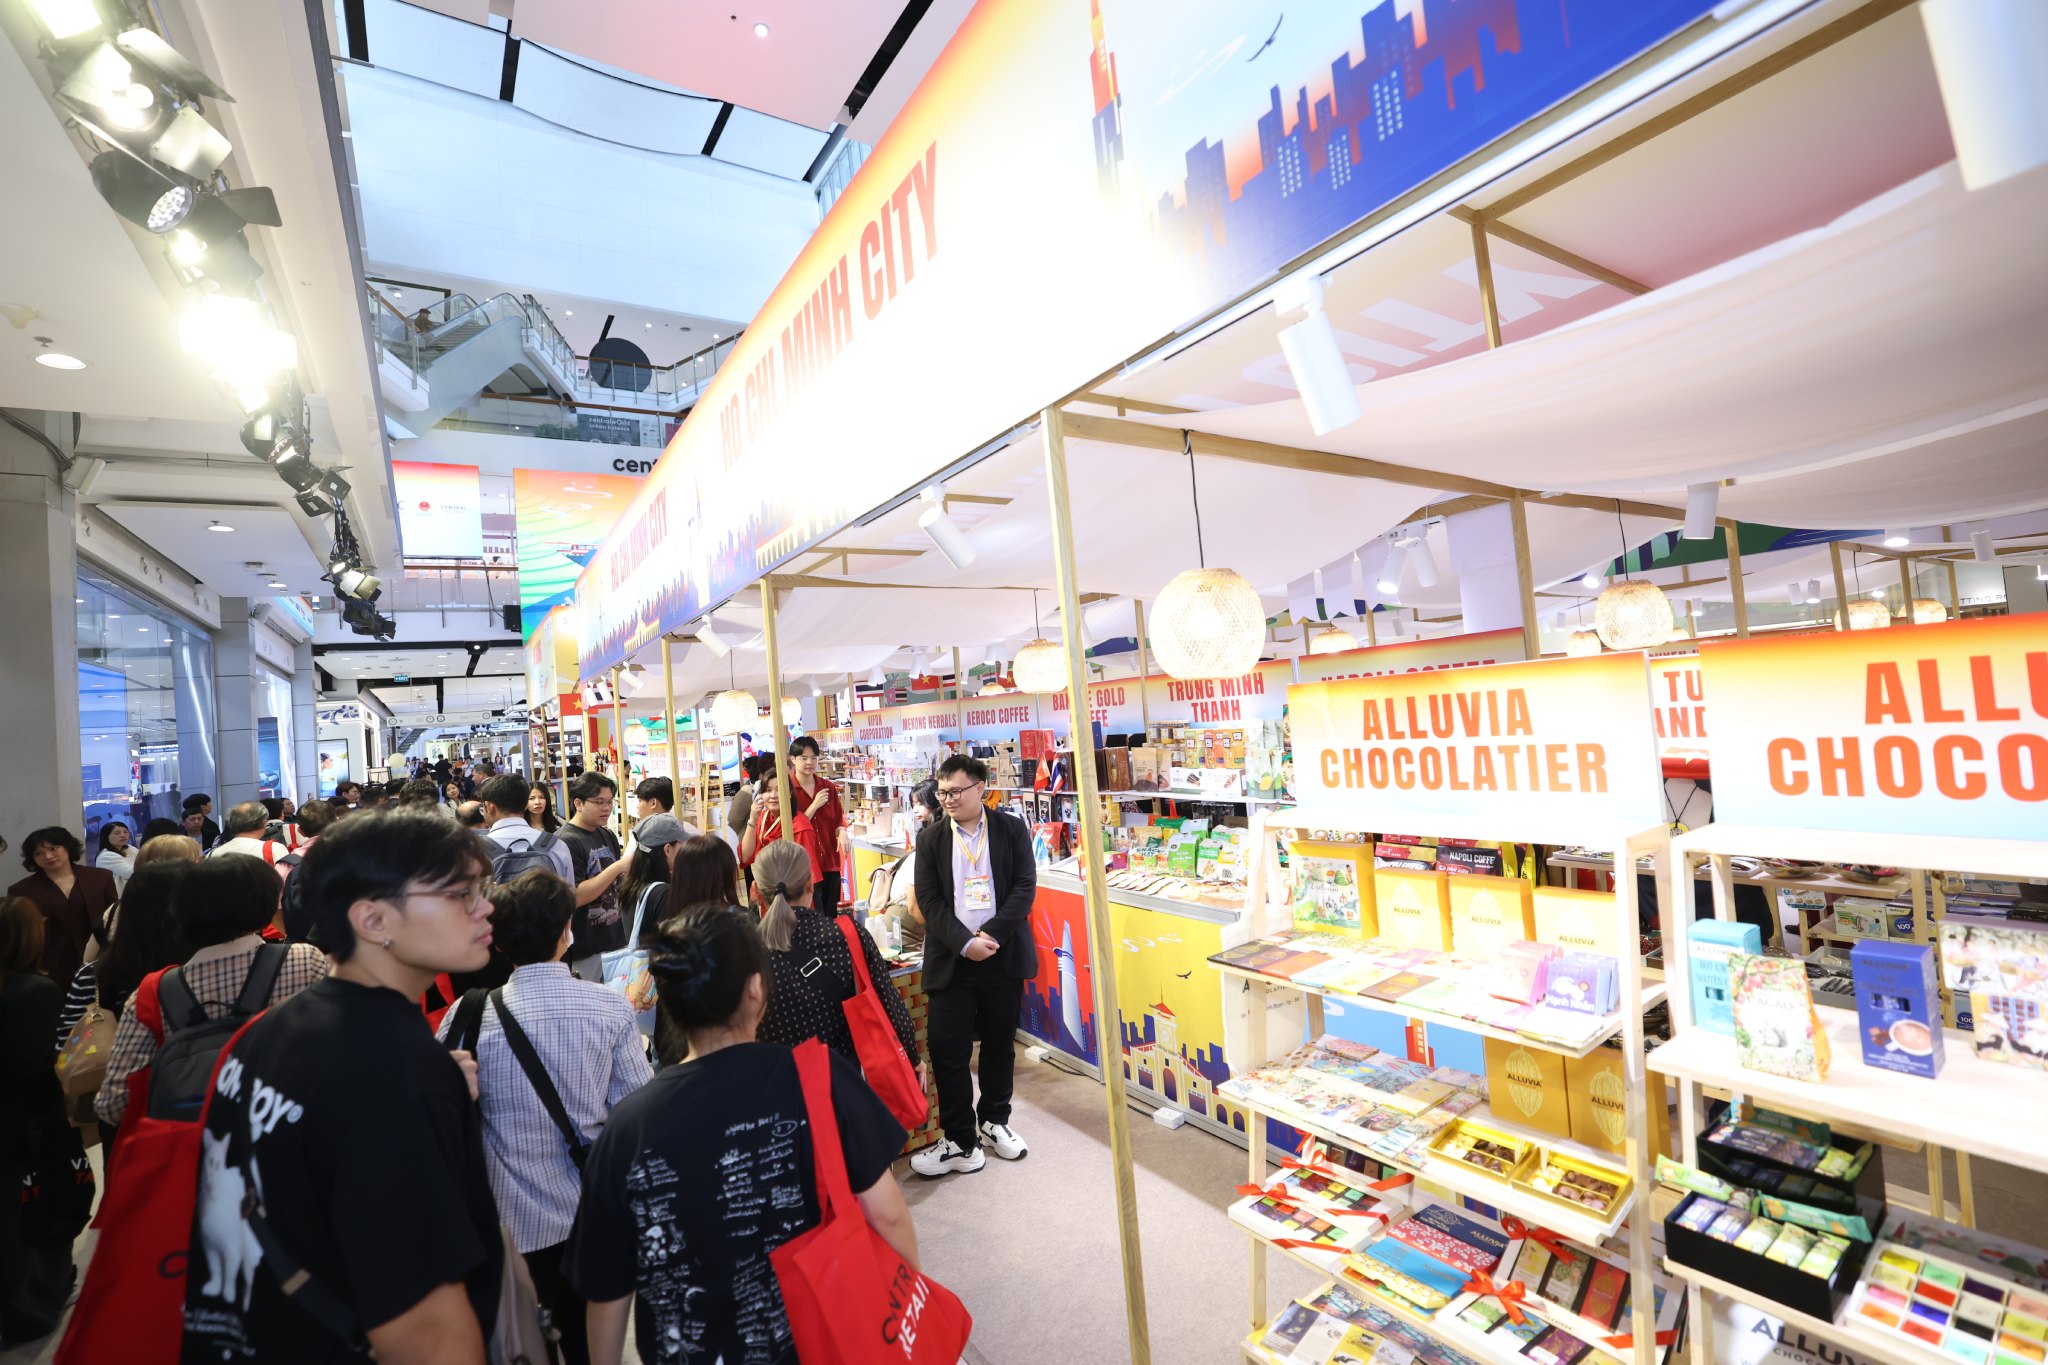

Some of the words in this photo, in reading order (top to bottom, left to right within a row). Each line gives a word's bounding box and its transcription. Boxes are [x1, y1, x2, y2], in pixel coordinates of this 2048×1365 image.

[720, 393, 741, 473] HO
[745, 347, 778, 443] CHI
[780, 253, 854, 406] MINH
[859, 139, 938, 321] CITY
[613, 458, 658, 473] cen
[649, 486, 667, 550] CITY
[1167, 679, 1215, 702] TRUNG
[1221, 672, 1265, 698] MINH
[1096, 686, 1125, 707] GOLD
[967, 708, 996, 726] AEROCO
[999, 706, 1030, 724] COFFEE
[1191, 700, 1242, 723] THANH
[1363, 688, 1534, 740] ALLUVIA
[902, 716, 927, 731] MEKONG
[928, 713, 957, 729] HERBALS
[860, 727, 893, 741] CORPORATION
[1320, 743, 1609, 792] CHOCOLATIER
[1449, 851, 1473, 863] NAPOLI
[1393, 906, 1421, 916] ALLUVIA
[1470, 916, 1502, 926] ALLUVIA
[1559, 935, 1596, 946] ALLUVIA
[1507, 1073, 1542, 1088] ALLUVIA
[1591, 1096, 1626, 1111] ALLUVI
[1470, 1230, 1508, 1248] ALLUVIA
